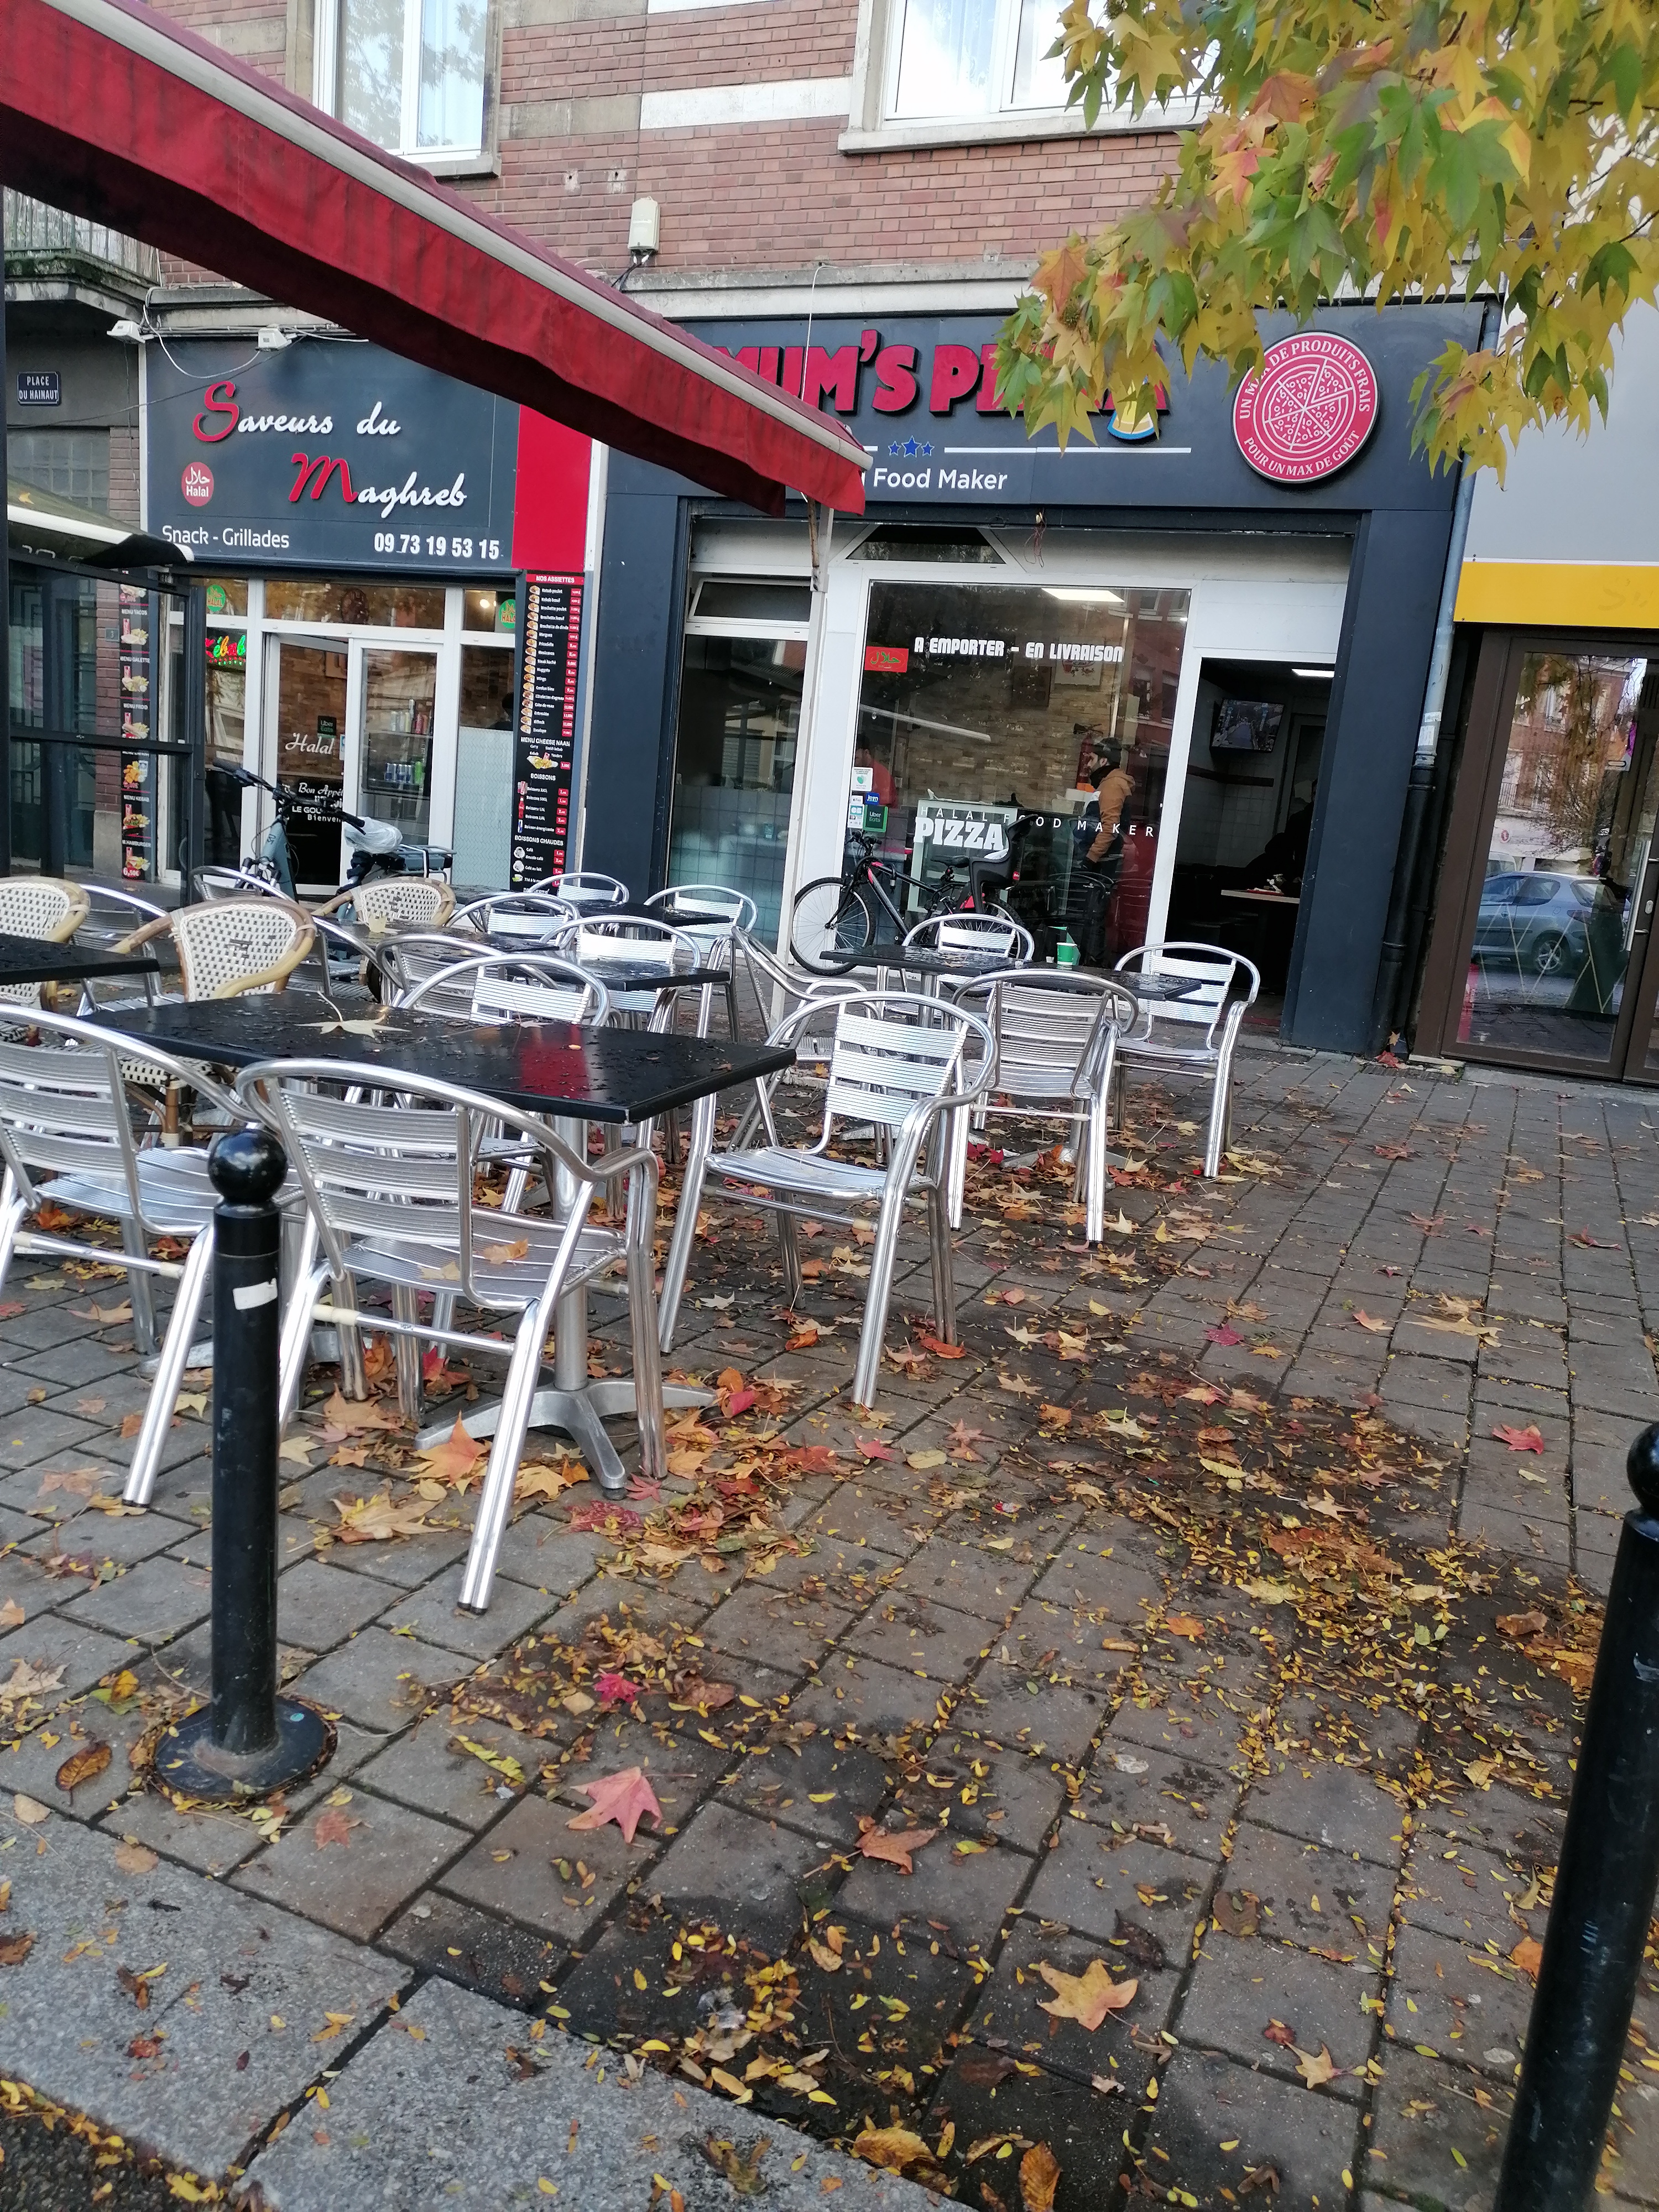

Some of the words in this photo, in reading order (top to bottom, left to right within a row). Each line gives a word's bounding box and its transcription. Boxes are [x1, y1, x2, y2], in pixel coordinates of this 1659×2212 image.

[27, 376, 49, 386] PLACE
[1240, 398, 1253, 419] UN
[1268, 347, 1289, 367] DE
[1291, 340, 1360, 369] PRODUITS
[1354, 368, 1371, 412] FRAIS
[19, 390, 27, 399] DU
[30, 390, 58, 400] HAINAUT
[192, 381, 332, 442] Saveurs
[356, 401, 401, 435] du
[1244, 437, 1269, 467] POUR
[1268, 461, 1286, 474] UN
[1286, 463, 1313, 476] MAX
[1315, 456, 1333, 472] DE
[185, 466, 210, 485] حلال
[291, 453, 467, 519] Maghreb
[873, 468, 931, 488] Food
[938, 468, 1008, 489] Maker
[186, 486, 209, 497] Halal
[162, 525, 208, 544] Snack
[223, 528, 290, 548] Grillades
[374, 533, 394, 553] 09
[400, 534, 420, 554] 73
[426, 535, 446, 556] 19
[452, 538, 472, 558] 53
[479, 539, 499, 560] 15
[207, 598, 223, 607] HALAL
[110, 630, 114, 638] 3
[915, 637, 924, 653] A
[930, 638, 1004, 656] EMPORTER
[1025, 642, 1045, 658] EN
[1050, 643, 1123, 662] LIVRAISON
[285, 733, 335, 755] Halal
[299, 782, 315, 794] Bon
[921, 807, 988, 822] HALAL
[1077, 820, 1154, 837] MAKER
[514, 834, 539, 843] BOISSONS
[540, 838, 564, 846] CHAUDES
[914, 817, 1004, 851] PIZZA
[123, 868, 139, 877] 6,50€
